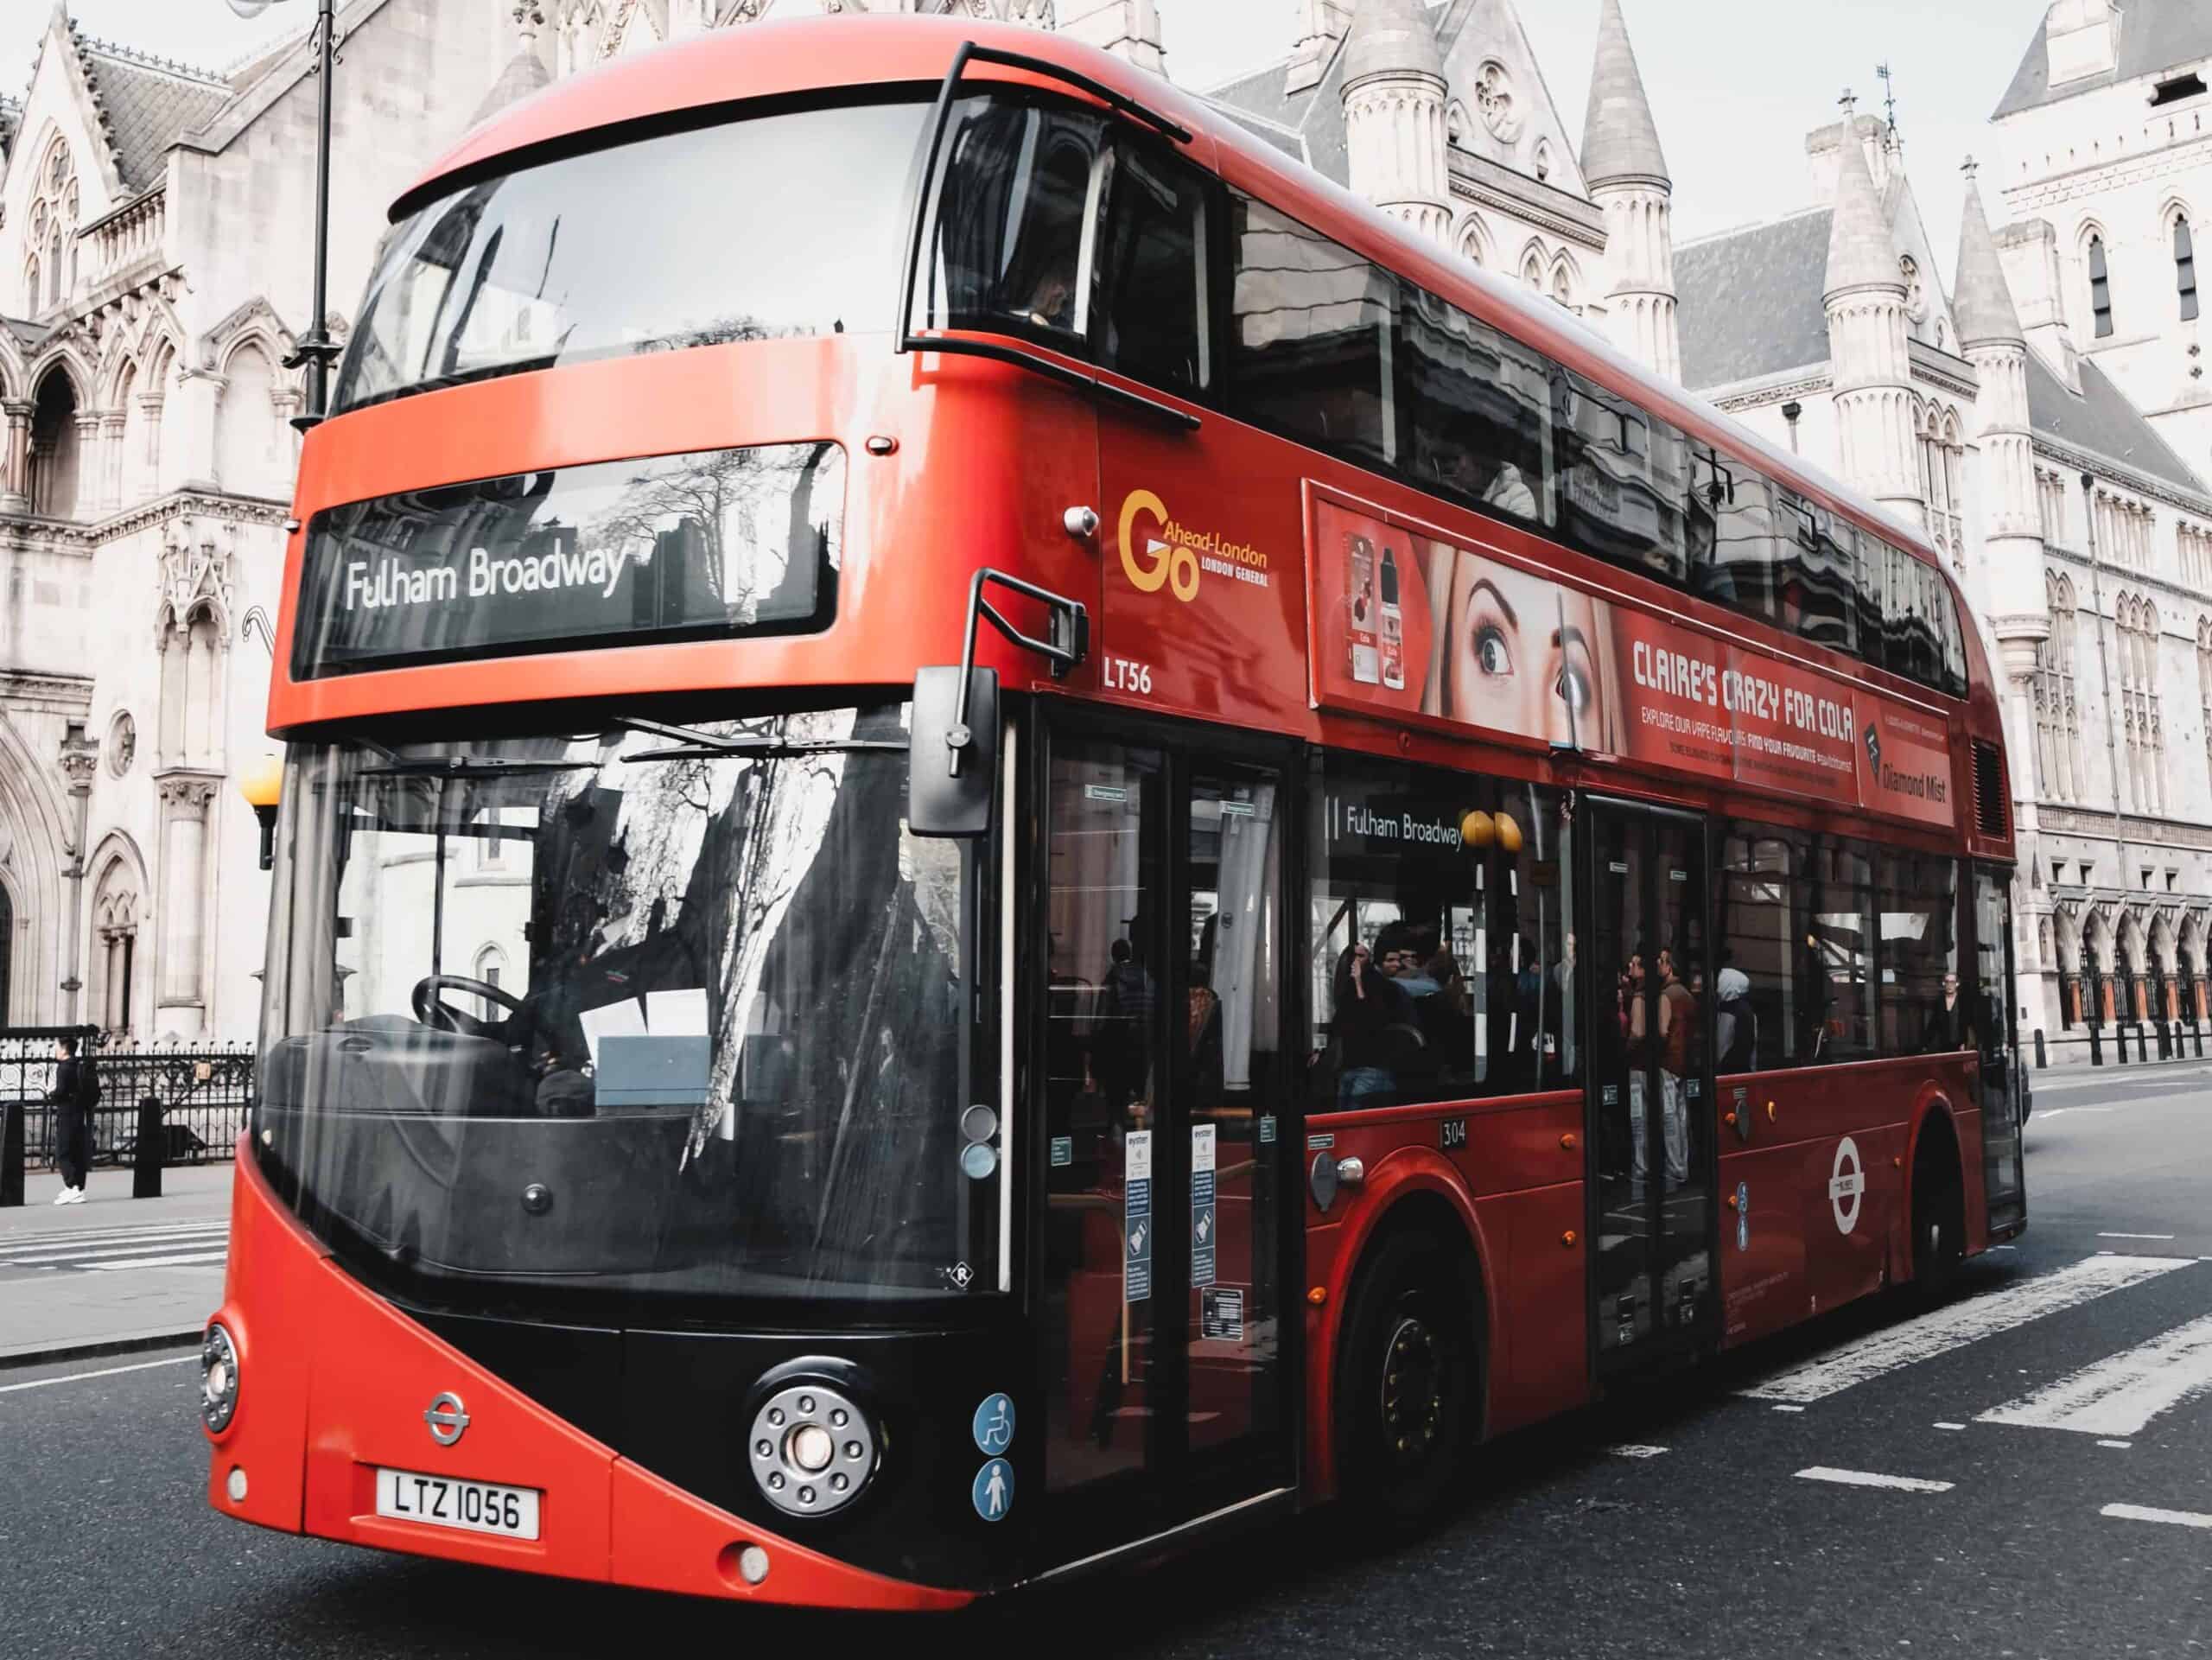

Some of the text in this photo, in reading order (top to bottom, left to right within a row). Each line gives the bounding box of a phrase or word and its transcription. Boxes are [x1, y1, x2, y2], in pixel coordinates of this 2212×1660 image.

[1163, 520, 1268, 569] Ahead-London
[346, 538, 627, 611] Fulham Broadway
[1201, 556, 1269, 588] LONDON GENERAL
[1103, 657, 1153, 695] LT56
[1633, 640, 1718, 706] CLAIRE'S
[1722, 670, 1780, 722] CRAZY
[1784, 688, 1815, 732] FOR
[1818, 699, 1853, 743] COLA
[1642, 705, 1675, 731] EXPLORE
[1675, 716, 1691, 736] OUR
[1692, 720, 1711, 741] VAPE
[1882, 763, 1924, 798] Diamond
[1926, 775, 1946, 803] Mist
[1347, 805, 1398, 838] Fulham
[1402, 812, 1465, 852] Broadway
[1443, 1119, 1466, 1146] 304
[957, 1266, 969, 1281] R
[395, 1476, 520, 1530] LTZ 1056
